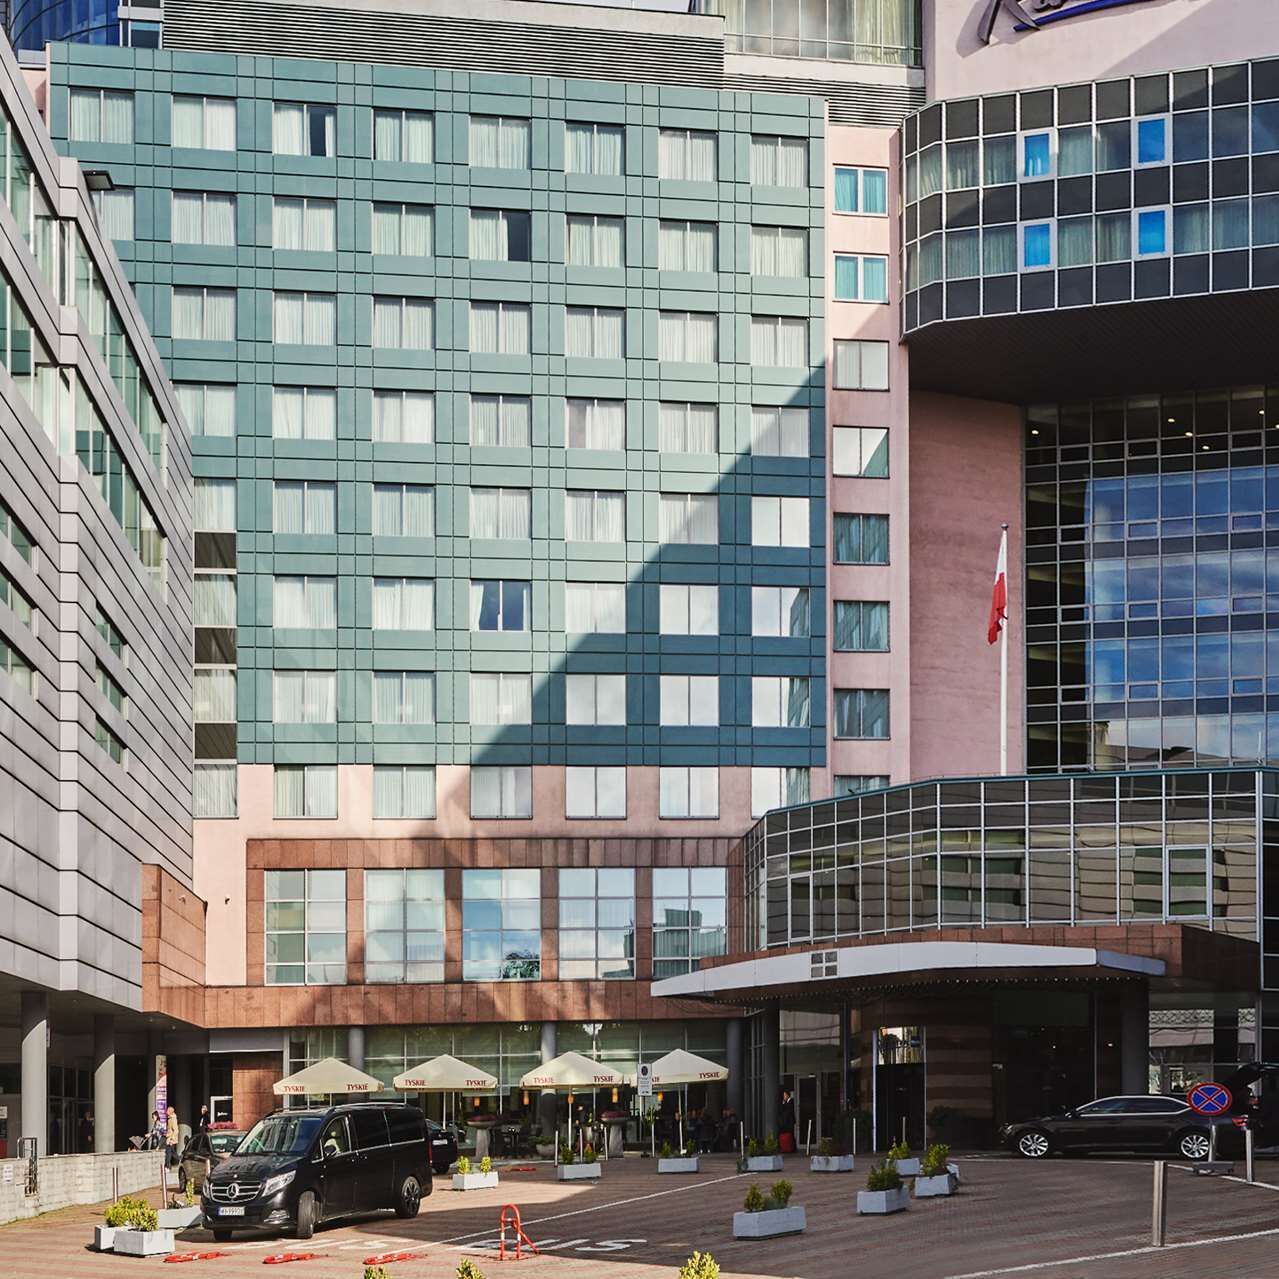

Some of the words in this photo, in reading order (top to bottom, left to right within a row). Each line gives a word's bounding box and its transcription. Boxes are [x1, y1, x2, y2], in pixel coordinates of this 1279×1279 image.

[404, 1079, 427, 1087] TYSKIE
[465, 1079, 488, 1087] TYSKIE
[593, 1075, 615, 1083] TYSKIE
[283, 1085, 306, 1093] TYSKIE
[346, 1083, 369, 1091] TYSKIE
